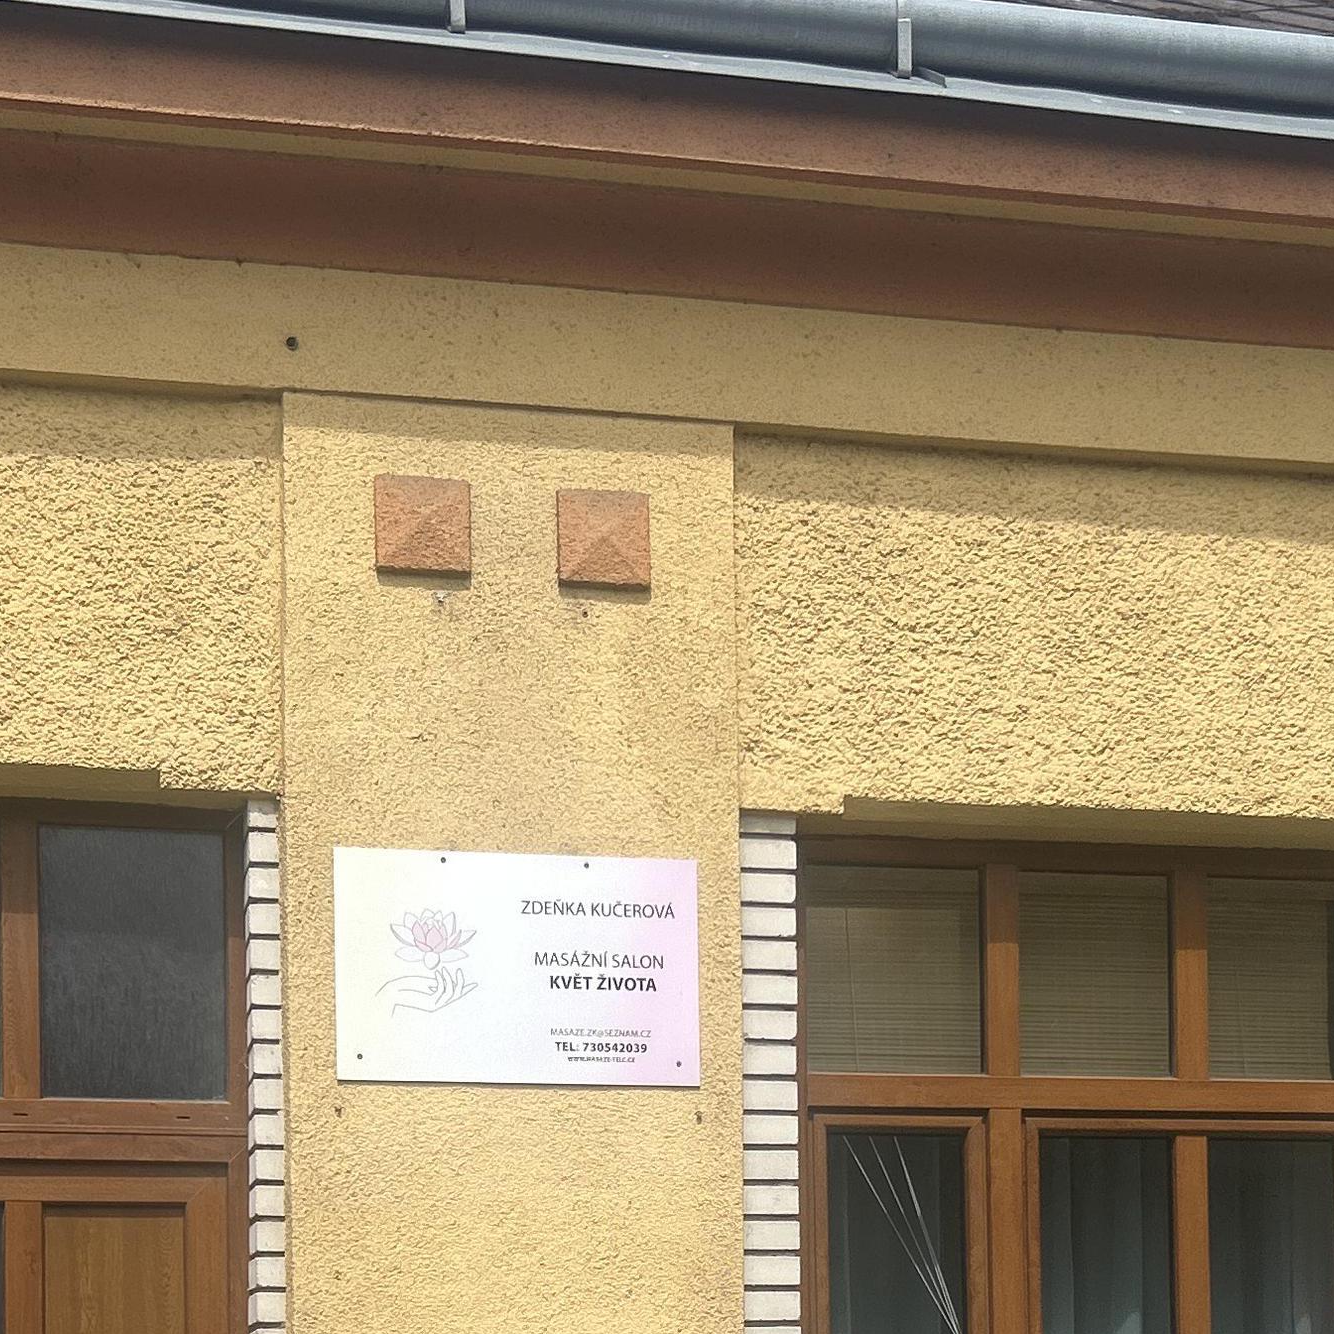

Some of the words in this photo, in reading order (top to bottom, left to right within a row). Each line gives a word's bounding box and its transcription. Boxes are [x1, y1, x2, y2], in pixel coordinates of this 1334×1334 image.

[521, 898, 587, 917] ZDEŇKA
[591, 901, 675, 919] KUČEROVÁ
[534, 950, 608, 968] MASÁŽNÍ
[612, 954, 665, 970] SALON
[550, 973, 593, 990] KVĚT
[596, 974, 657, 992] ŽIVOTA
[582, 1042, 648, 1053] 730542039
